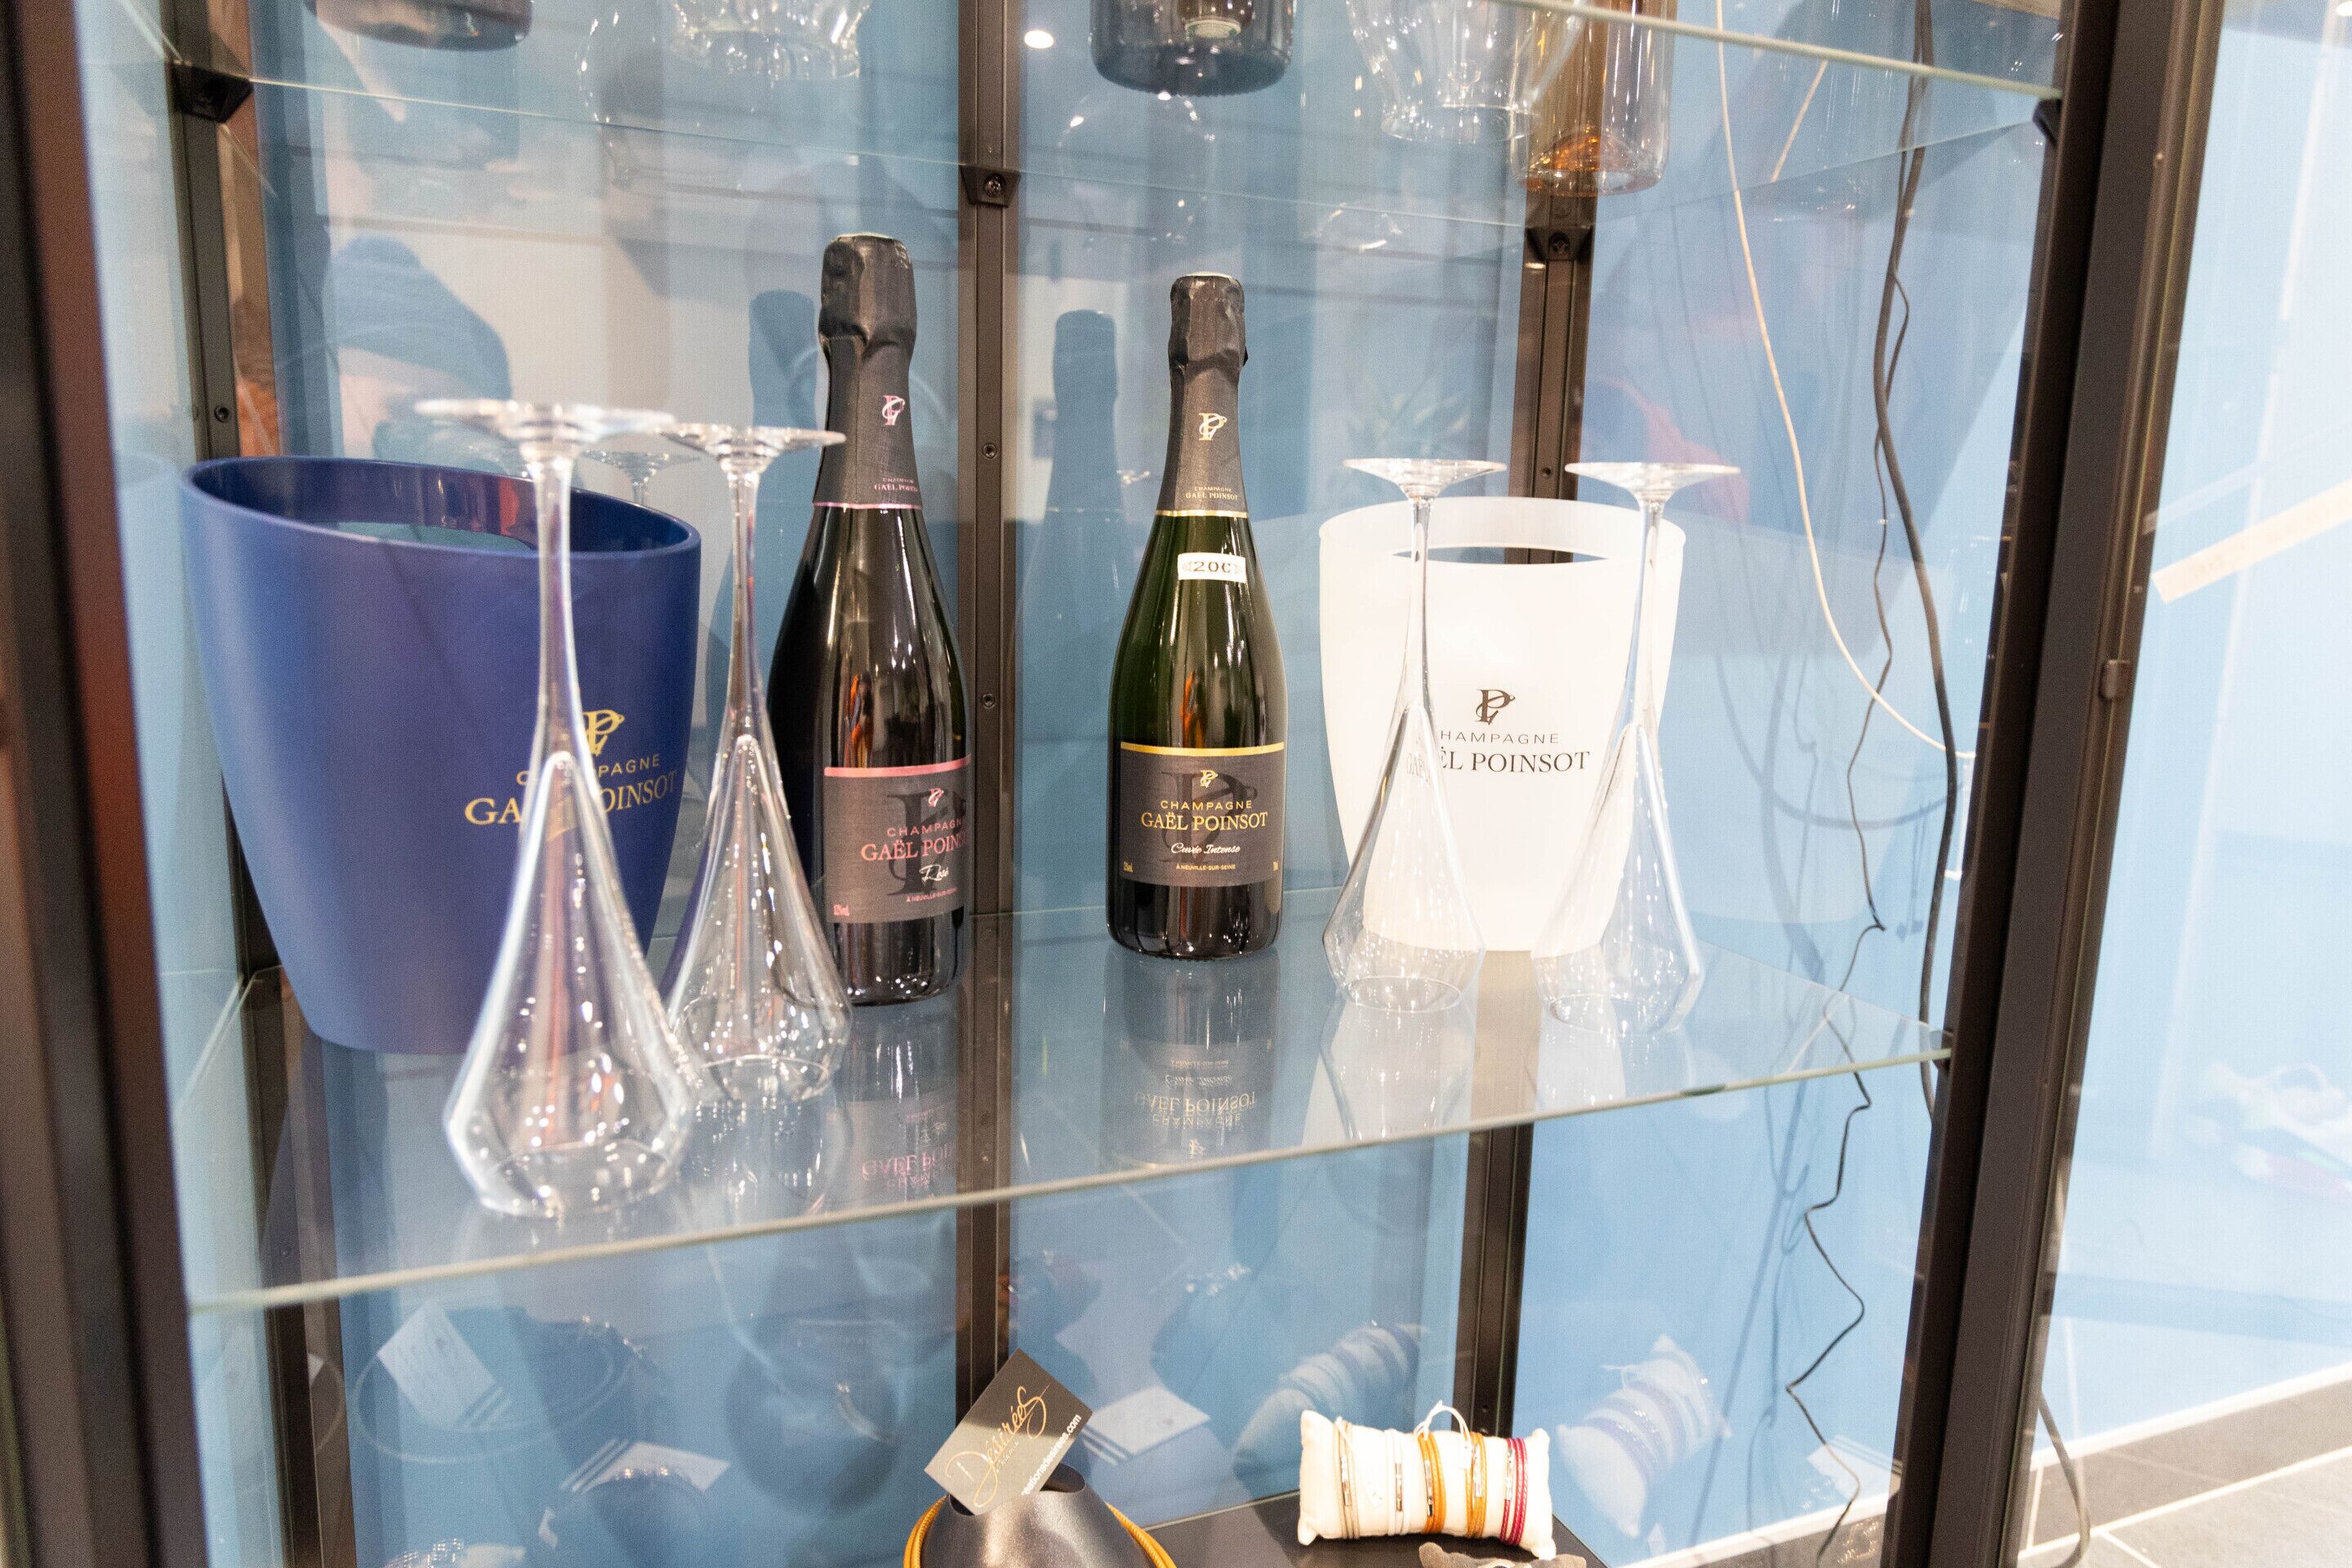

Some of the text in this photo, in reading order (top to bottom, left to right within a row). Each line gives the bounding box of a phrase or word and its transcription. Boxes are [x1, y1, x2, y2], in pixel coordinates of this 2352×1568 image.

[1441, 730, 1559, 744] HAMPAGNE
[516, 754, 660, 786] CPAGNE
[1472, 751, 1590, 773] POINSOT
[464, 770, 677, 825] GA OINSOT
[1160, 800, 1252, 810] CHAMPAGNE
[886, 818, 964, 837] CHAMPAGN
[1141, 811, 1268, 831] GAËL POINSOT
[861, 840, 920, 861] GAËL
[1170, 842, 1241, 854] Cuvée Intense
